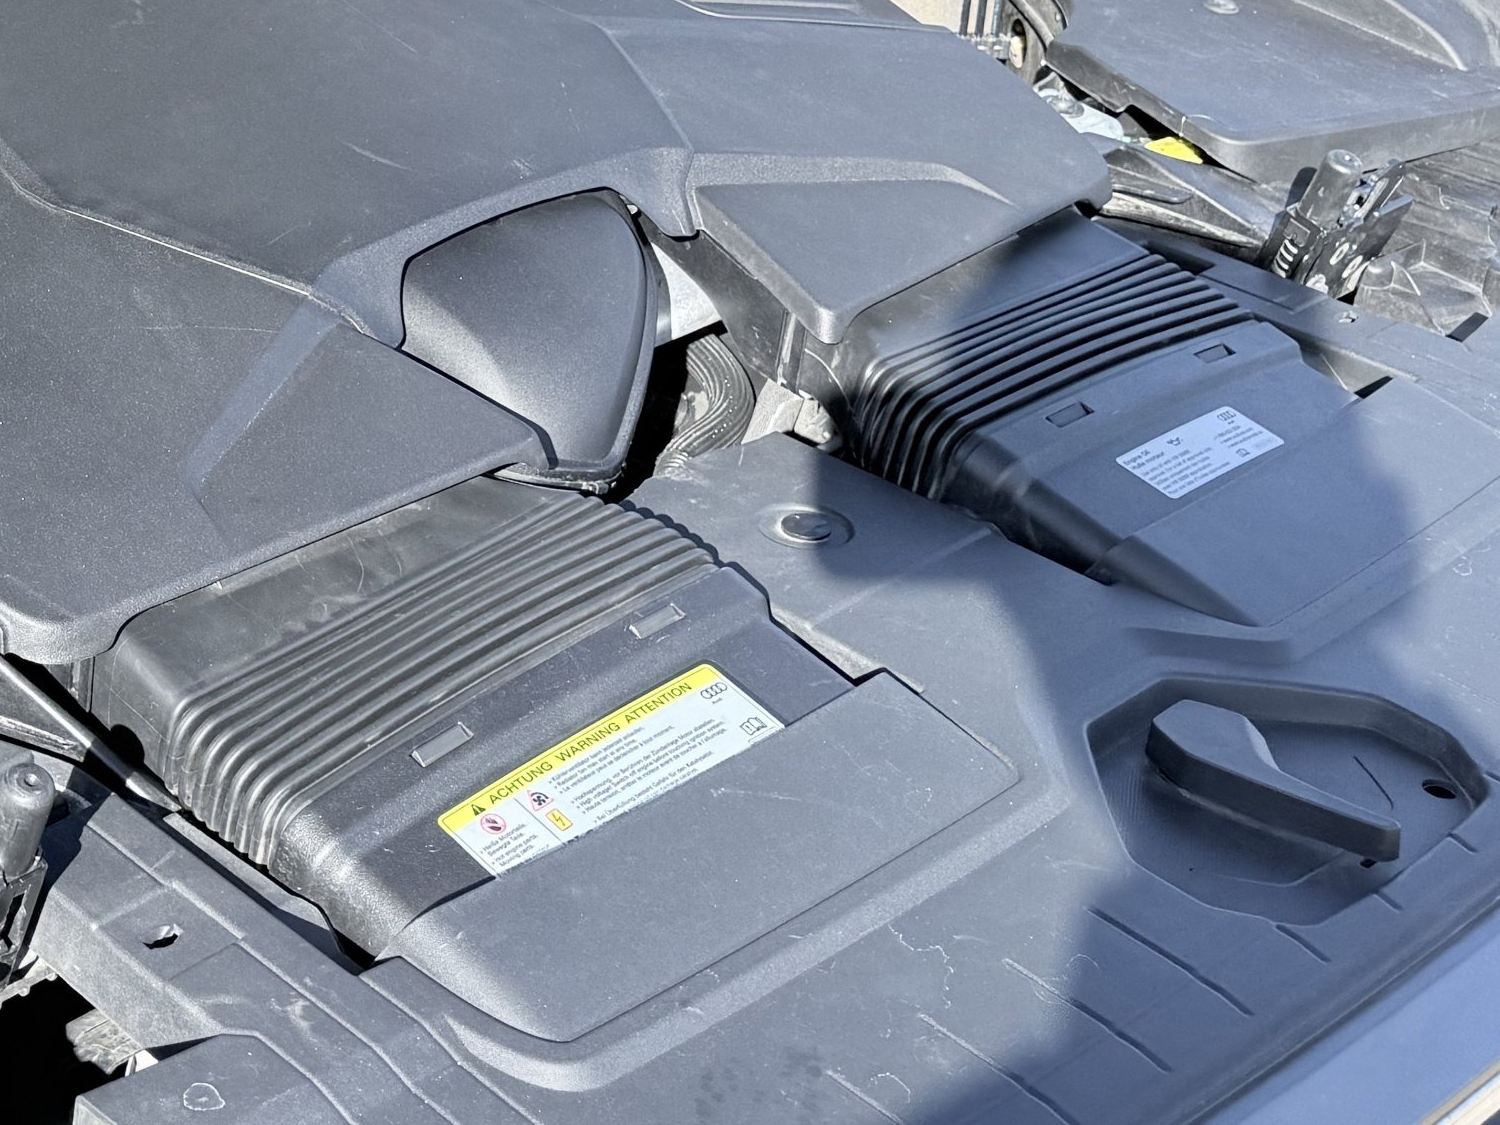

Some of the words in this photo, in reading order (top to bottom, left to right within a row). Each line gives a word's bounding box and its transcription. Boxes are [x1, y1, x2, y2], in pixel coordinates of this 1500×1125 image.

[490, 761, 552, 804] ACHTUNG
[555, 723, 620, 761] WARNING
[625, 683, 691, 723] ATTENTION
